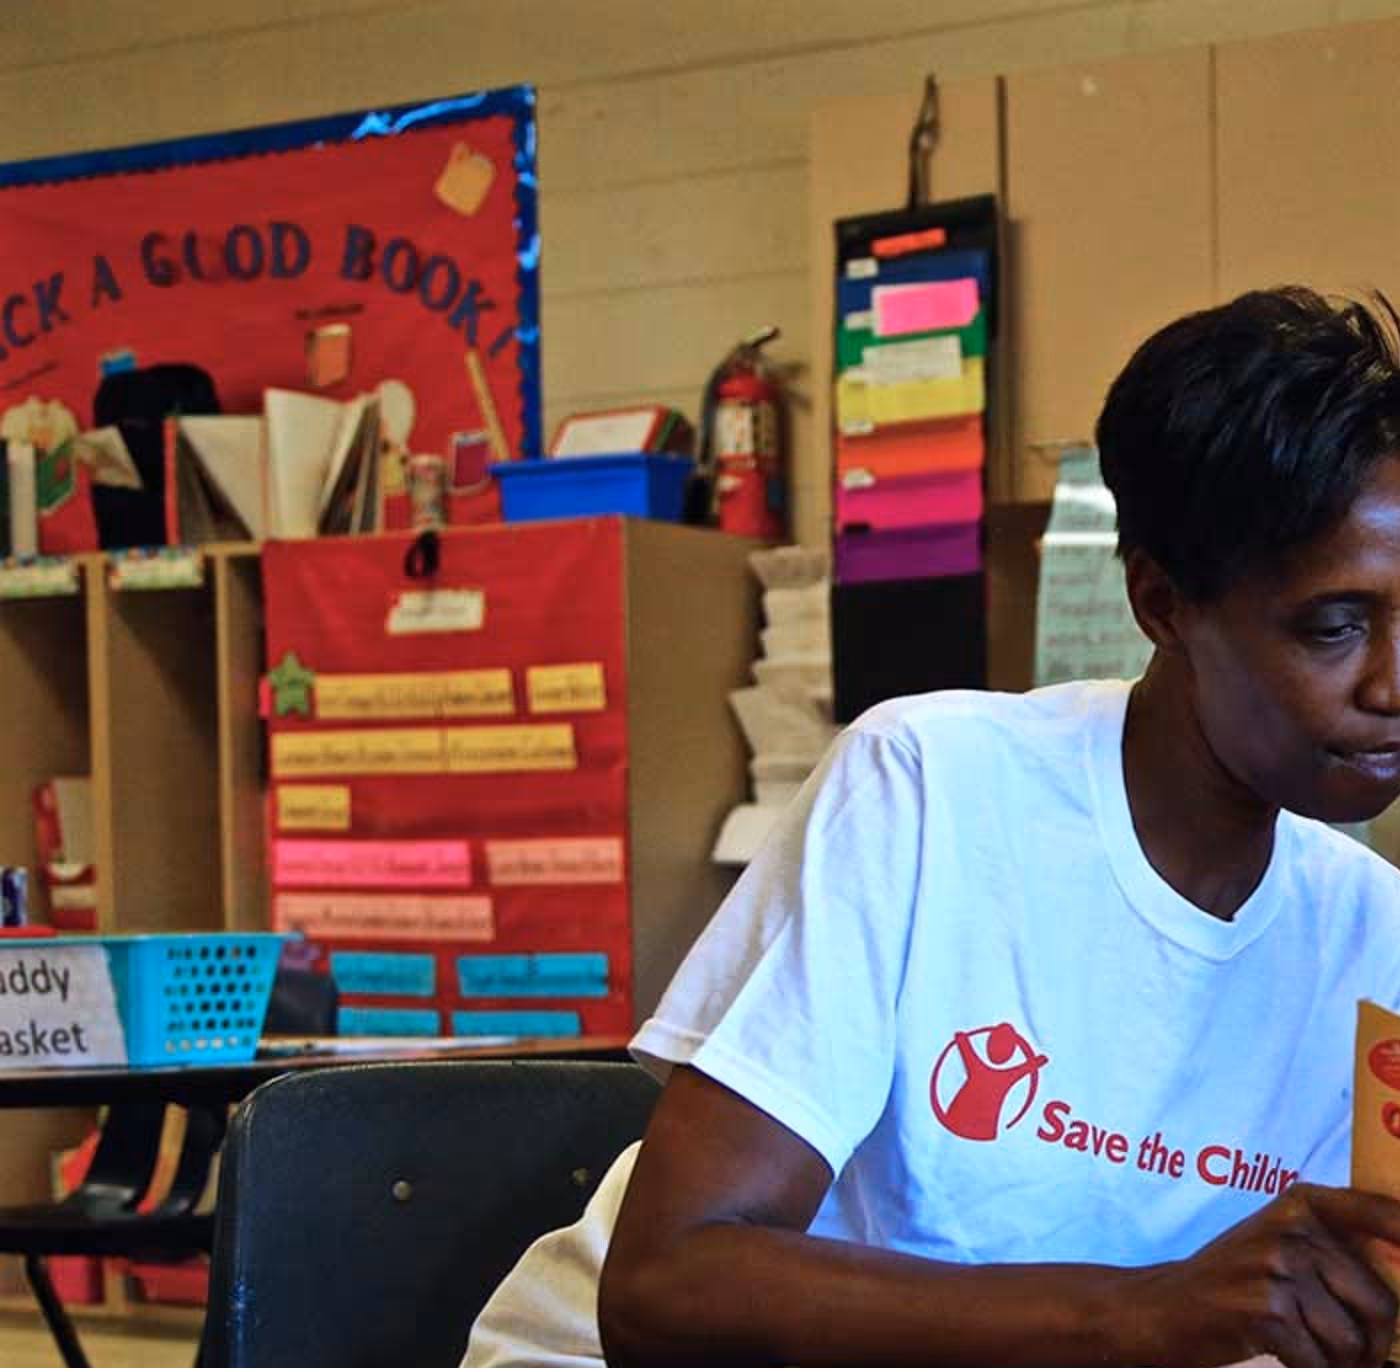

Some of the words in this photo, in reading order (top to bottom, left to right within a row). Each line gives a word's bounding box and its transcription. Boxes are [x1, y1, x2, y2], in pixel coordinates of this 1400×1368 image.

[0, 271, 70, 362] CK
[90, 253, 122, 310] A
[140, 221, 312, 289] GOOD
[1037, 1100, 1128, 1164] Save
[1137, 1132, 1185, 1179] the
[1197, 1145, 1299, 1196] Childr
